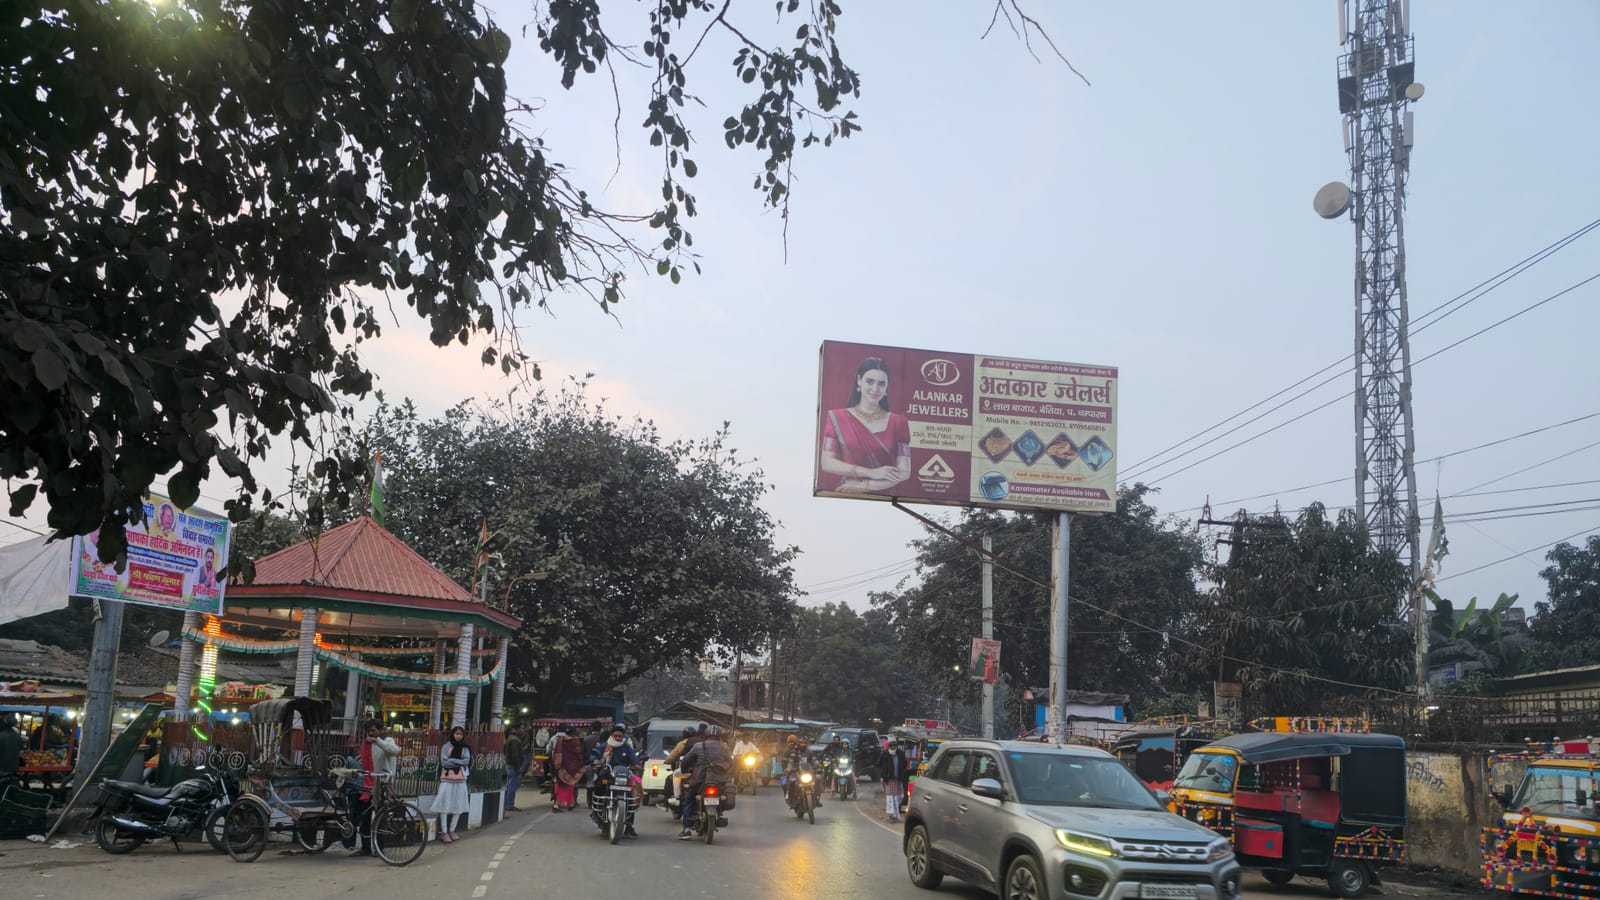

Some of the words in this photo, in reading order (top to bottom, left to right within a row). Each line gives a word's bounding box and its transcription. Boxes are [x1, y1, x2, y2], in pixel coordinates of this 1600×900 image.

[979, 371, 1048, 398] अलंकार
[1054, 377, 1112, 404] ज्वेलर्स
[913, 390, 963, 404] ALANKAR
[906, 403, 969, 418] JEWELLERS
[993, 402, 1010, 411] लाल
[985, 416, 1009, 425] Mobile
[1051, 487, 1084, 496] Available
